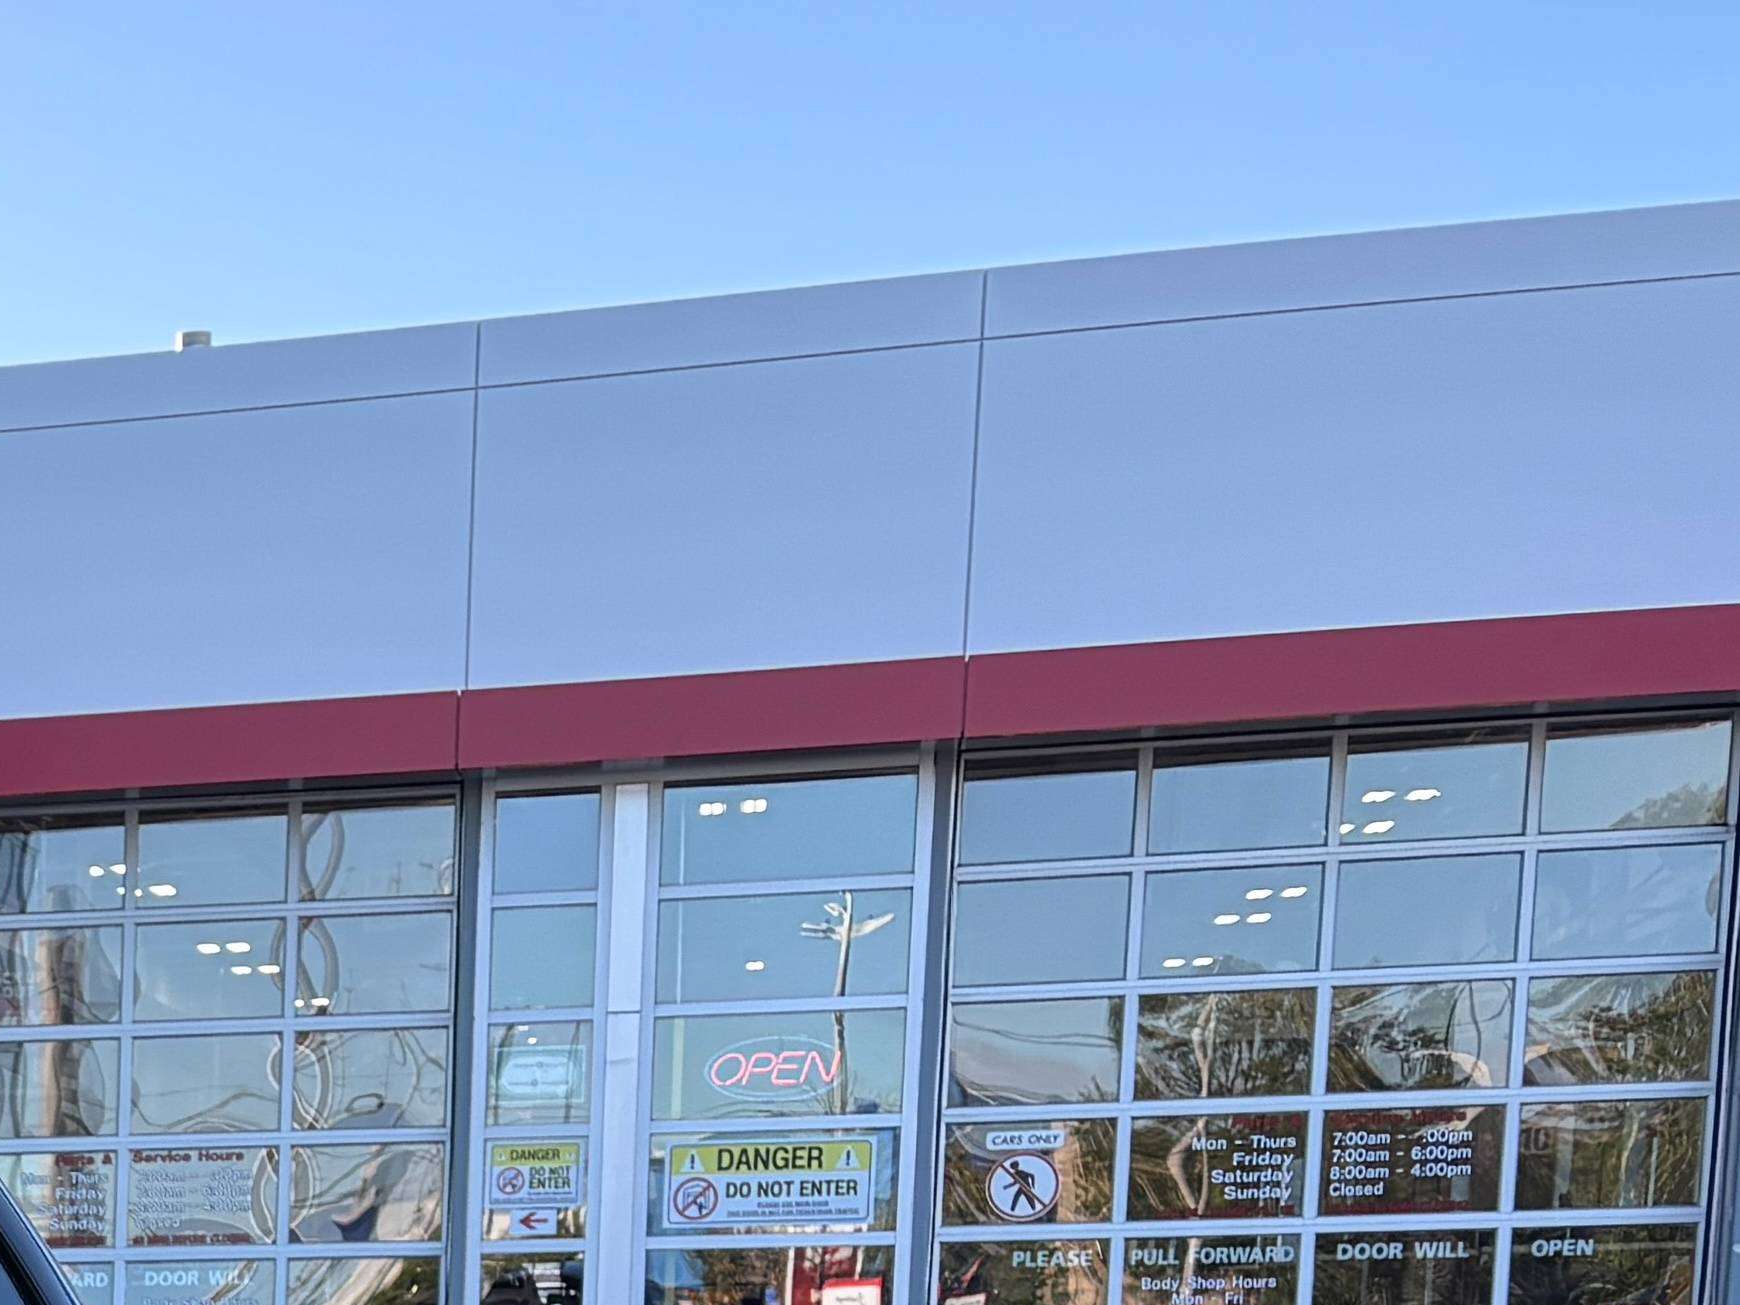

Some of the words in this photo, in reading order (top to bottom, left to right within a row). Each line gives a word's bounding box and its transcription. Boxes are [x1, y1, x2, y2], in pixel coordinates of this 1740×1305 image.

[710, 1051, 842, 1087] OPEN
[992, 1133, 1023, 1146] CARS
[1028, 1132, 1061, 1146] ONLY
[1191, 1136, 1227, 1151] Mon
[1249, 1134, 1297, 1148] Thurs
[1332, 1131, 1391, 1146] 7:00am
[1422, 1128, 1473, 1145] :00pm
[509, 1148, 561, 1162] DANGER
[716, 1146, 824, 1171] DANGER
[1232, 1151, 1294, 1168] Friday
[1332, 1147, 1390, 1163] 7:00am
[1410, 1145, 1473, 1162] 6:00pm
[529, 1166, 546, 1177] DO
[549, 1166, 570, 1177] NOT
[1211, 1168, 1294, 1185] Saturday
[1329, 1164, 1390, 1180] 8:00am
[1410, 1162, 1472, 1178] 4:00pm
[529, 1176, 571, 1190] ENTER
[725, 1181, 751, 1199] DO
[757, 1180, 795, 1198] NOT
[799, 1179, 859, 1197] ENTER
[1224, 1184, 1292, 1202] Sunday
[1329, 1181, 1384, 1197] Closed
[55, 1186, 106, 1202] Friday
[48, 1217, 106, 1233] Sunday
[1012, 1249, 1093, 1267] PLEASE
[1130, 1248, 1180, 1266] PULL
[1190, 1245, 1295, 1264] FORWARD
[1336, 1242, 1404, 1261] DOOR
[1414, 1240, 1469, 1258] WILL
[1530, 1238, 1595, 1258] OPEN
[143, 1269, 200, 1287] DOOR
[1141, 1276, 1179, 1293] Body
[1188, 1275, 1226, 1292] Shop
[1232, 1275, 1277, 1289] Hours
[1224, 1292, 1243, 1305] Fri
